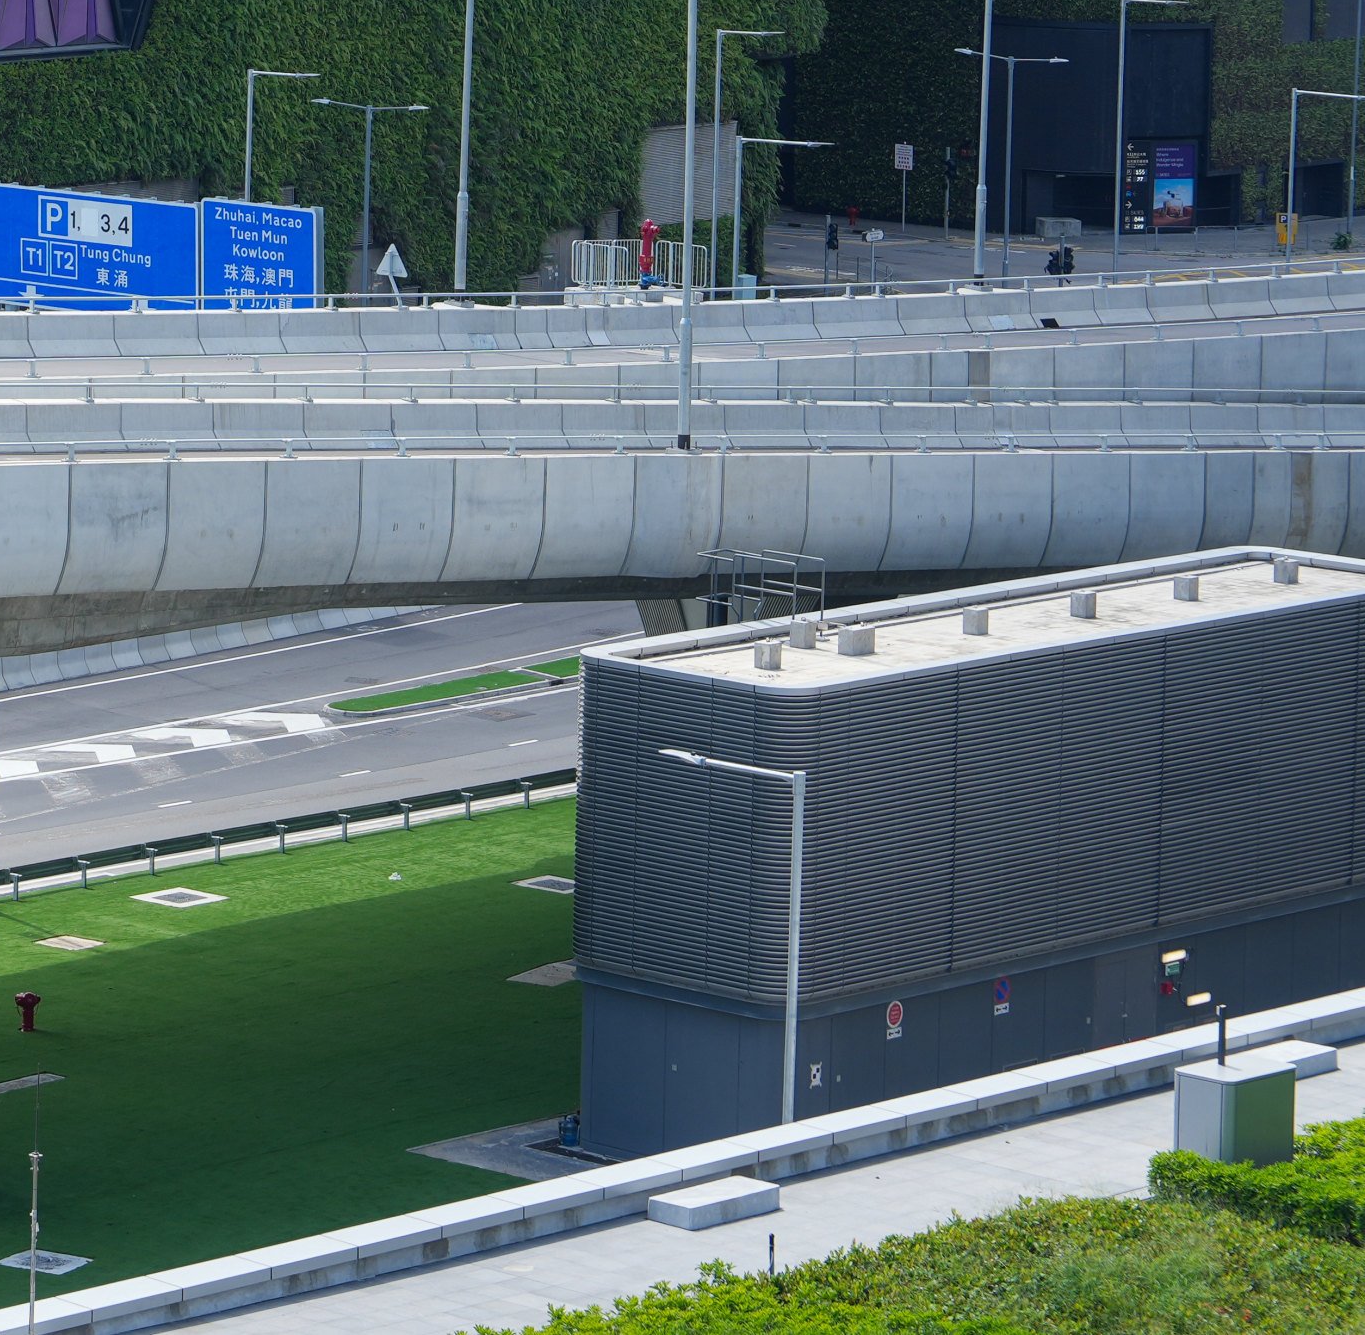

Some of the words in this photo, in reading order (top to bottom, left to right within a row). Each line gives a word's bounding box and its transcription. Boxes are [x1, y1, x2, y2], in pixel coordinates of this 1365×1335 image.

[215, 206, 259, 225] Zhuhai,
[262, 212, 302, 229] Macao
[1280, 215, 1287, 223] P
[230, 226, 258, 242] Tuen
[262, 230, 288, 245] Mun
[26, 247, 42, 266] T1
[53, 250, 75, 270] T2
[80, 245, 110, 263] Tung
[112, 248, 152, 268] Chung
[233, 243, 284, 262] Kowloon
[96, 267, 128, 288] 東涌
